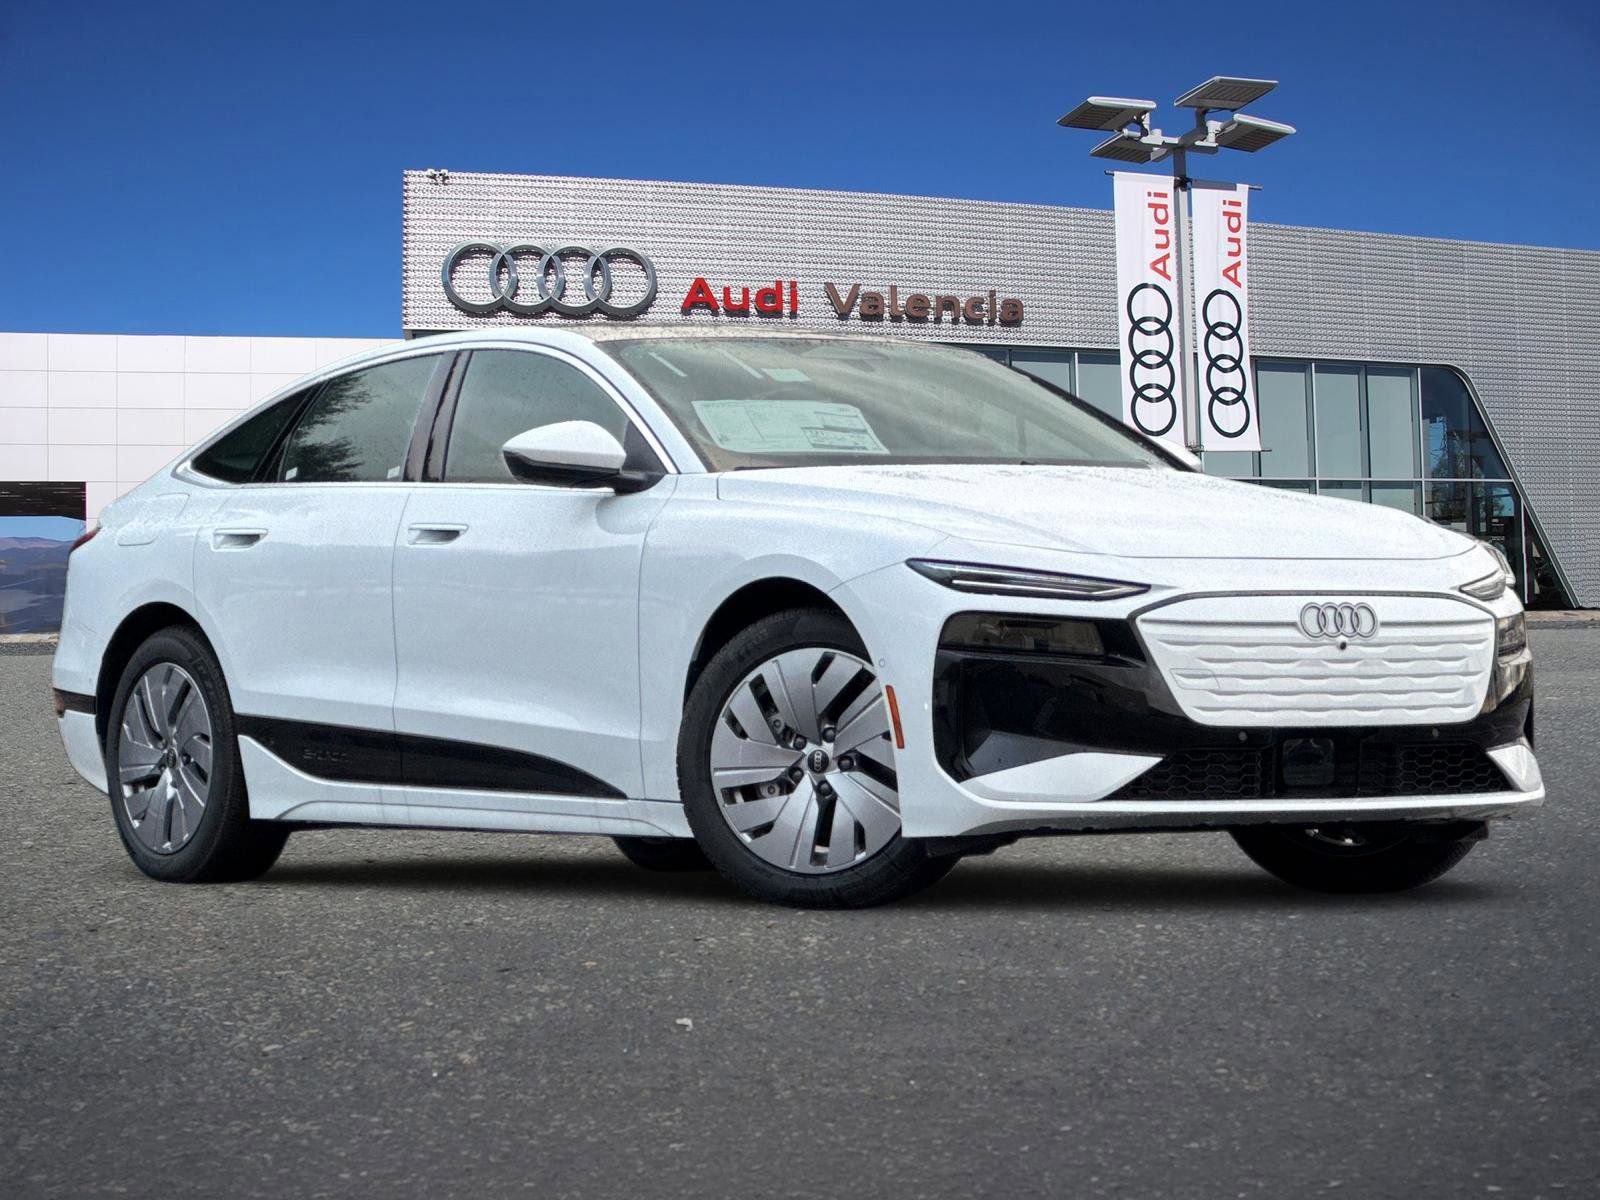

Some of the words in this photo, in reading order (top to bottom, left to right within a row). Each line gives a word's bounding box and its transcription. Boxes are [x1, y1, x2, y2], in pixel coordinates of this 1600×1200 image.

[1147, 191, 1171, 281] Audi
[1222, 199, 1242, 288] Audi
[681, 277, 799, 315] Audi
[824, 282, 1024, 324] Valencia
